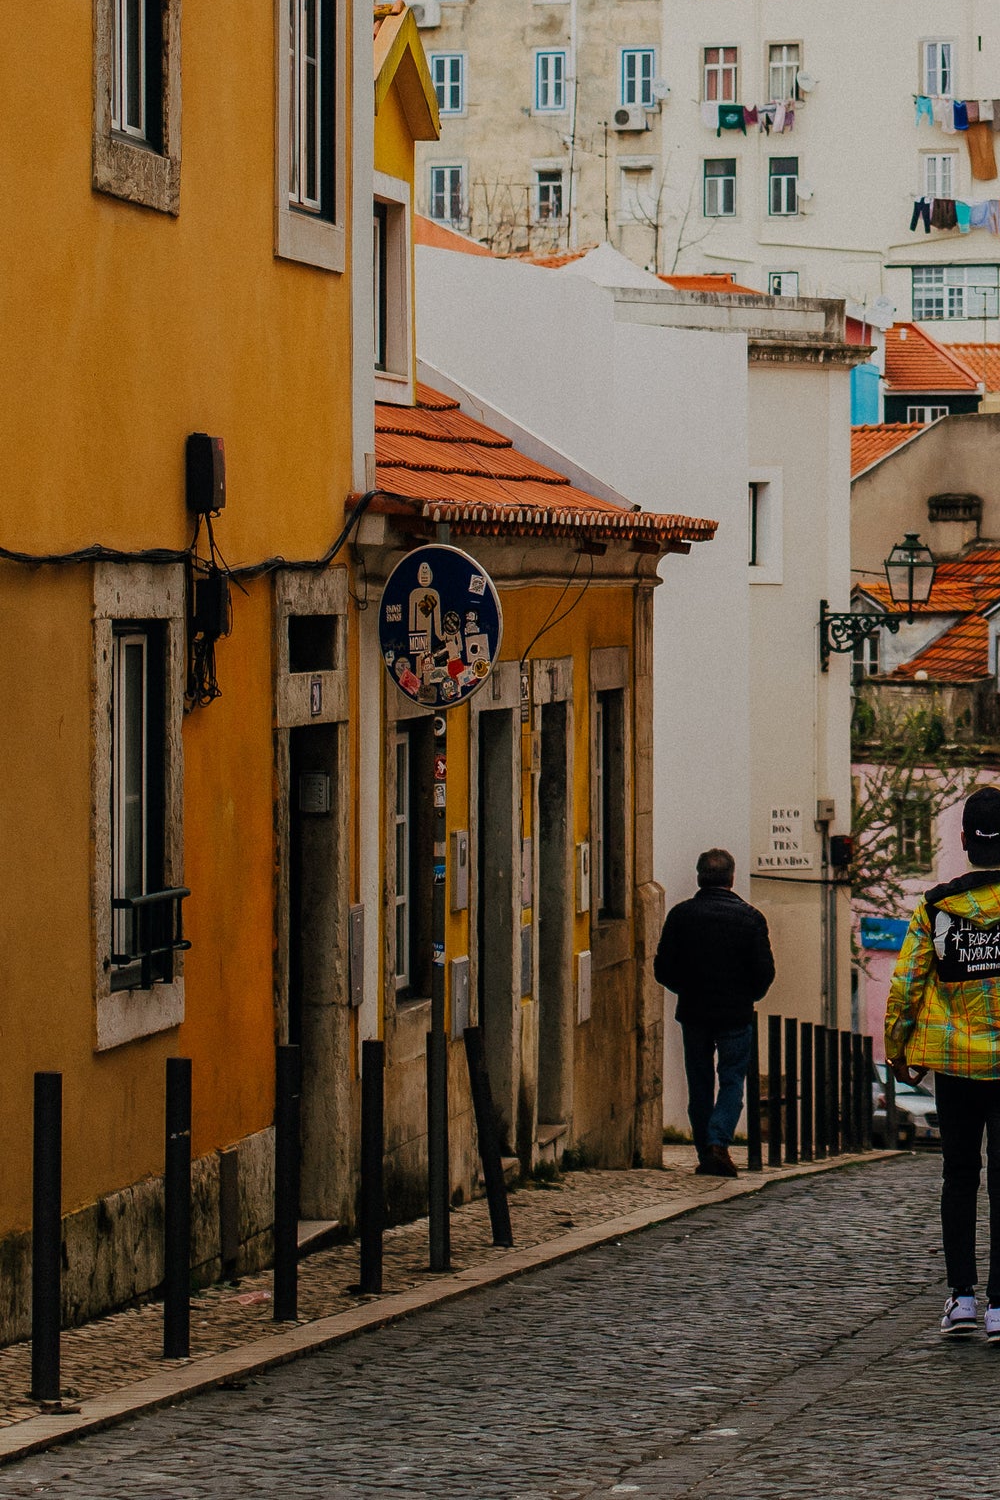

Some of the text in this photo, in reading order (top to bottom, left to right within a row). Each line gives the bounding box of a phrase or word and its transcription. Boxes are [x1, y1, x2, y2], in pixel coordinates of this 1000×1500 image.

[771, 810, 799, 818] BECO
[772, 825, 791, 833] DOS
[968, 932, 992, 947] BABY
[958, 948, 972, 962] IN
[971, 946, 993, 961] YOUR
